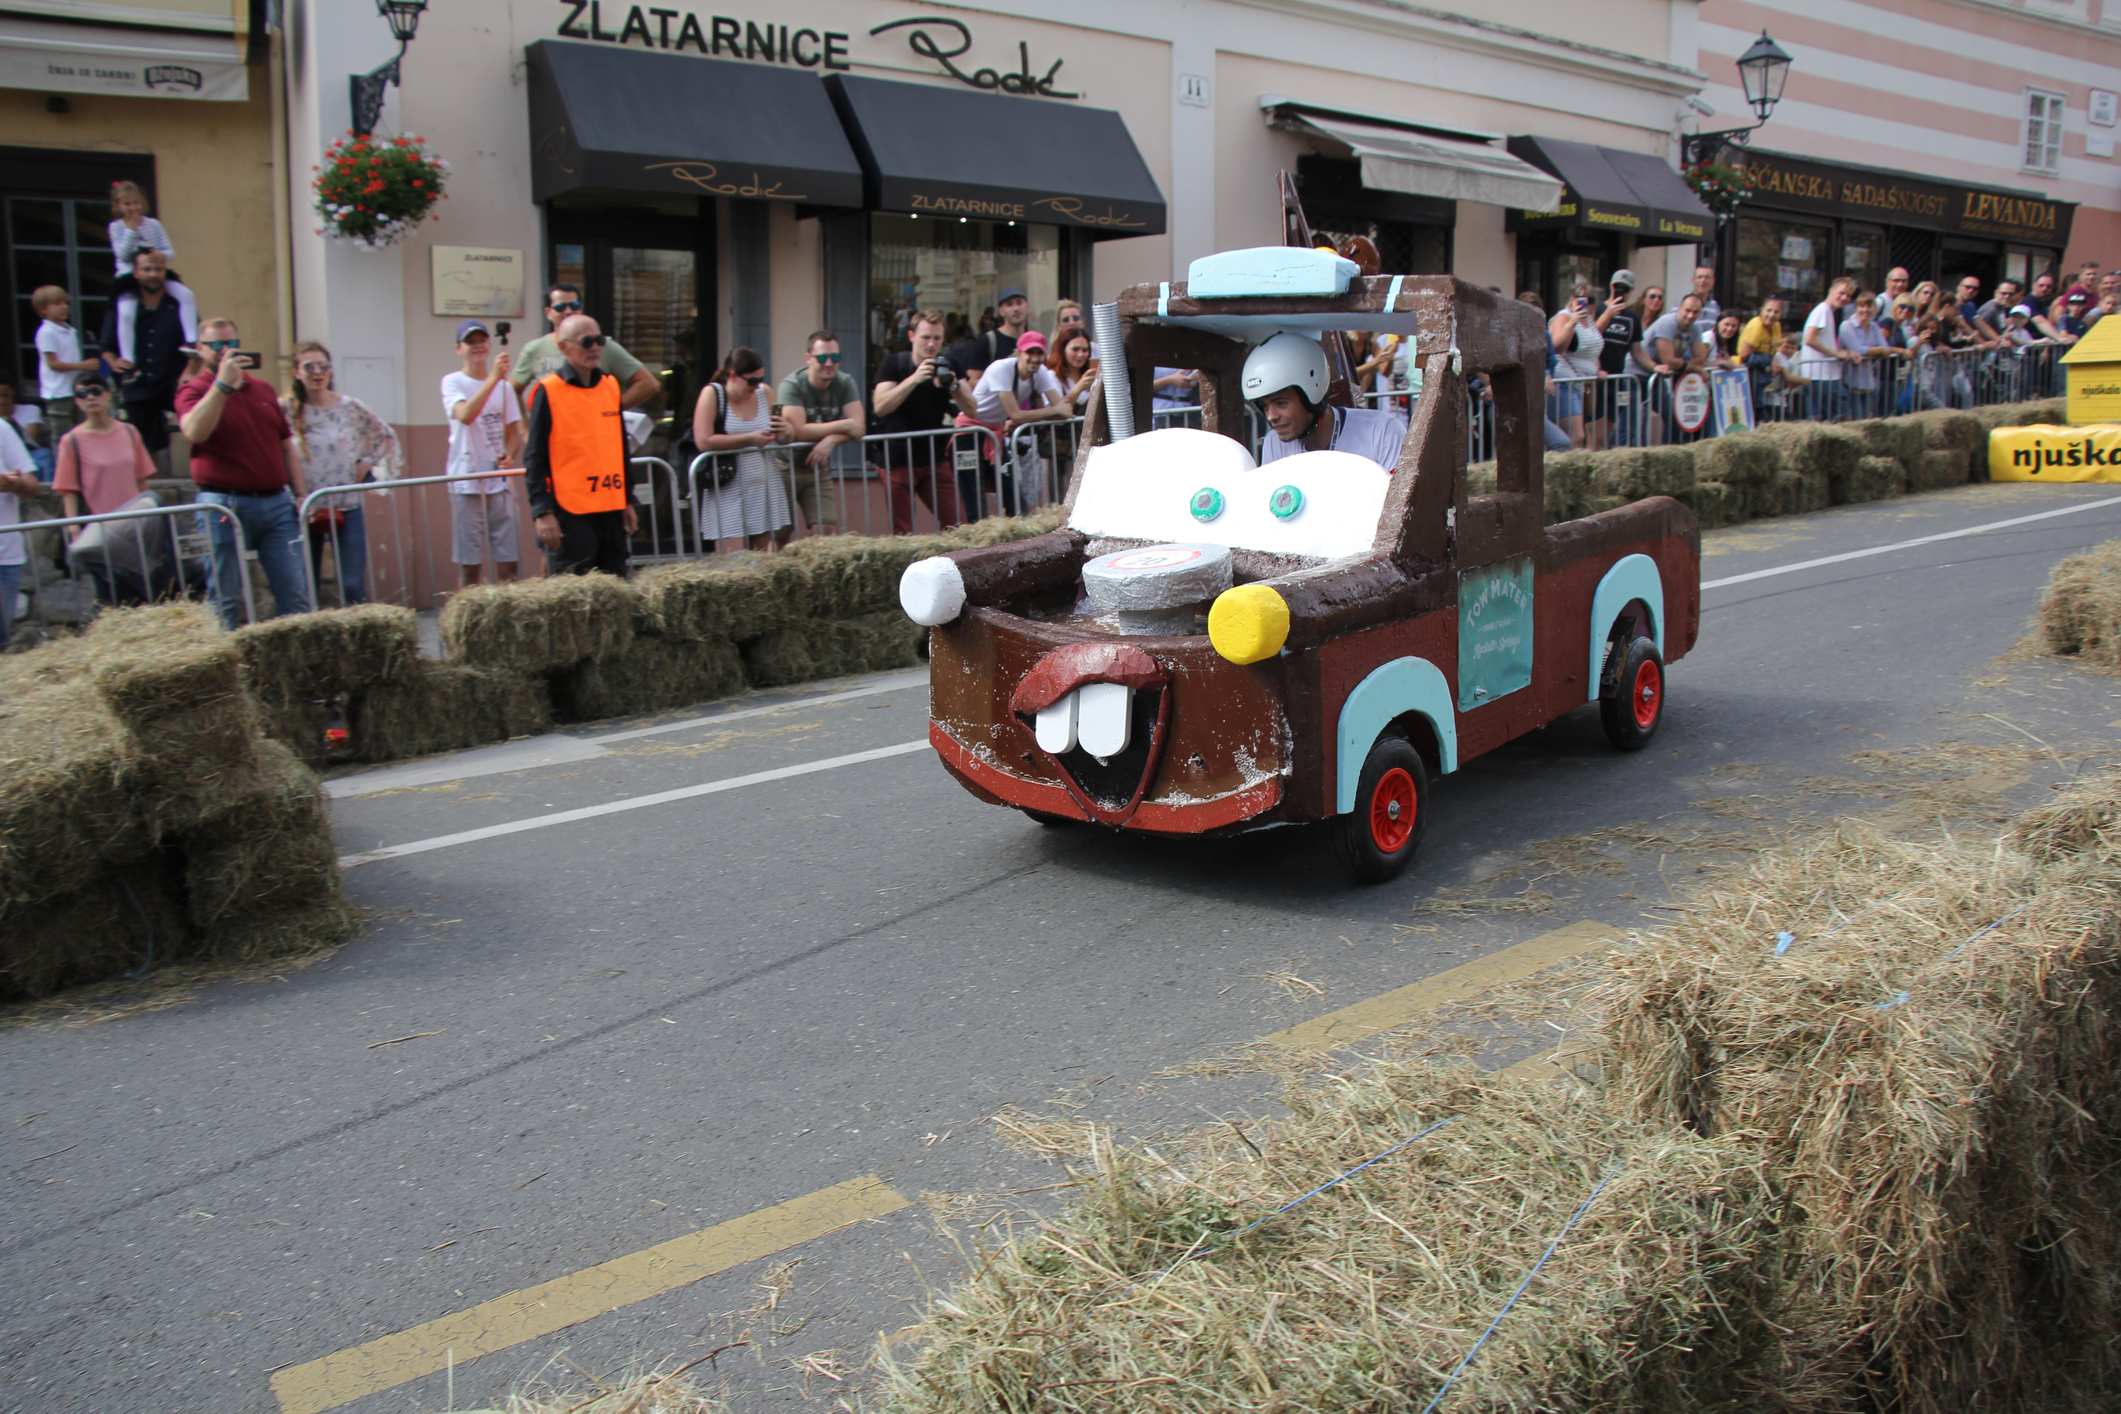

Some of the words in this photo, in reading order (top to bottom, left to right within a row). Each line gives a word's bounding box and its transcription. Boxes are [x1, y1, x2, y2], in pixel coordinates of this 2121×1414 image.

[558, 0, 850, 71] ZLATARNICE
[870, 17, 1079, 99] Rodić
[1188, 78, 1201, 97] 11
[644, 161, 807, 199] Rodić
[1746, 162, 1834, 199] ŠĆANSKA
[1840, 181, 1949, 217] SADAŠNJOST
[911, 194, 1025, 217] ZLATARNICE
[1032, 196, 1147, 227] Rodić
[1587, 208, 1641, 229] Souvenirs
[1963, 192, 2057, 229] LEVANDA
[1660, 217, 1673, 234] La
[1674, 218, 1704, 237] Verna
[586, 473, 623, 493] 746
[1122, 556, 1168, 566] 20
[1466, 587, 1489, 628] TOW
[1490, 578, 1528, 614] MATER
[1497, 633, 1521, 655] Springs
